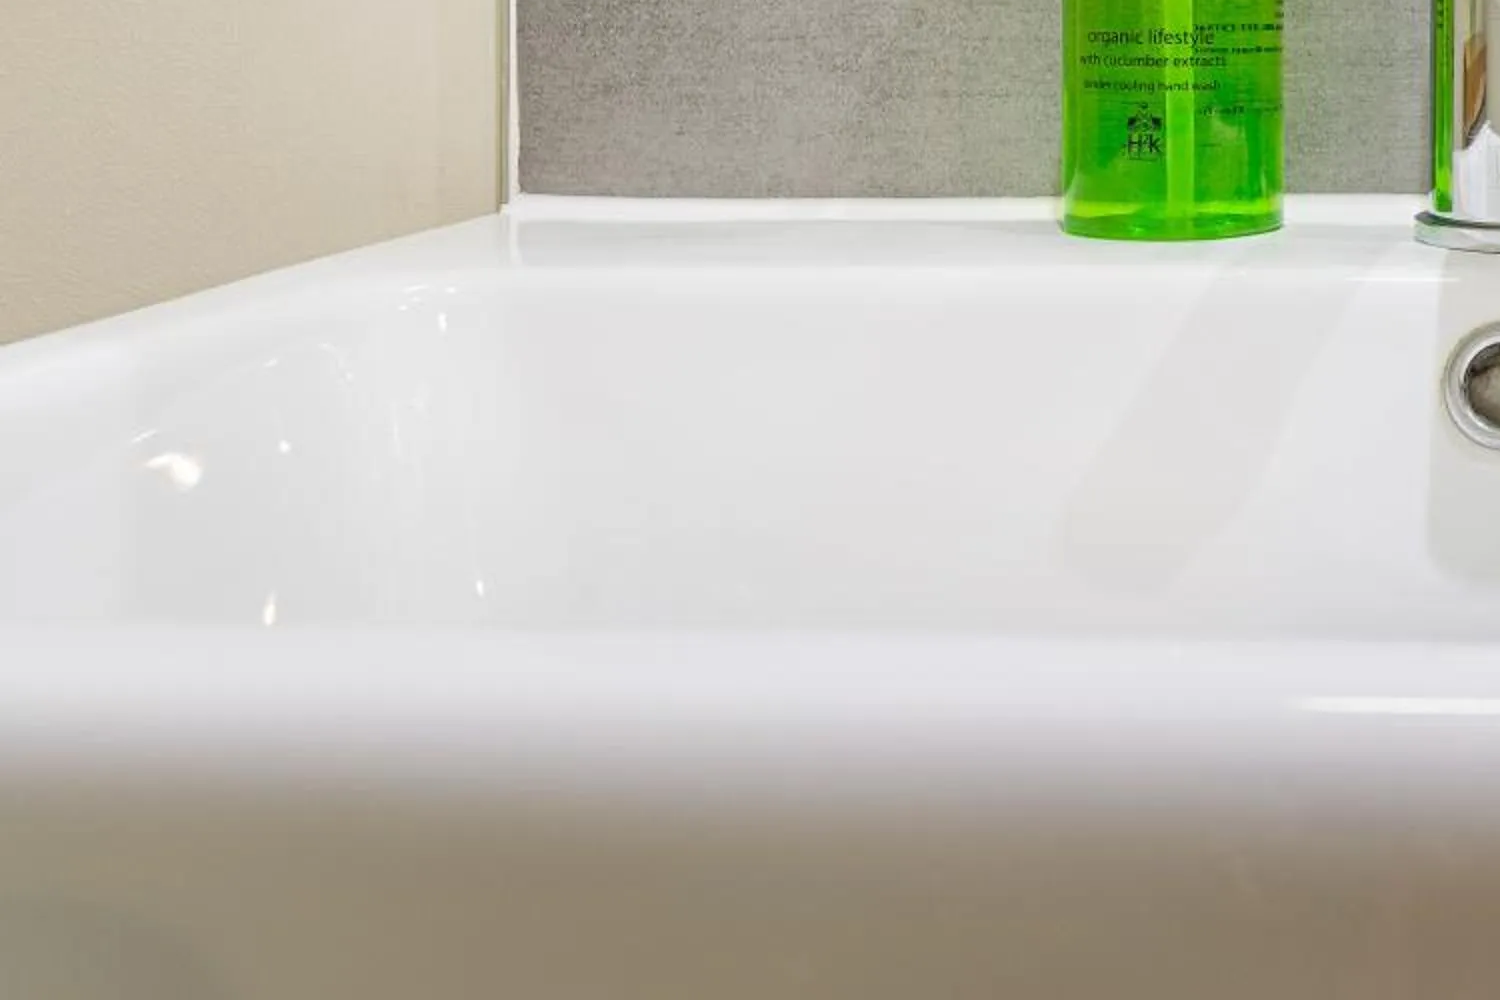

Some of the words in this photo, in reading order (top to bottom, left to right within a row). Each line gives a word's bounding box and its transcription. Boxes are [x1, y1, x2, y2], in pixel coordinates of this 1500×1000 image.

[1088, 30, 1143, 48] organic
[1148, 27, 1216, 47] lifestyle
[1103, 55, 1169, 68] cucumber
[1173, 55, 1227, 68] extracts
